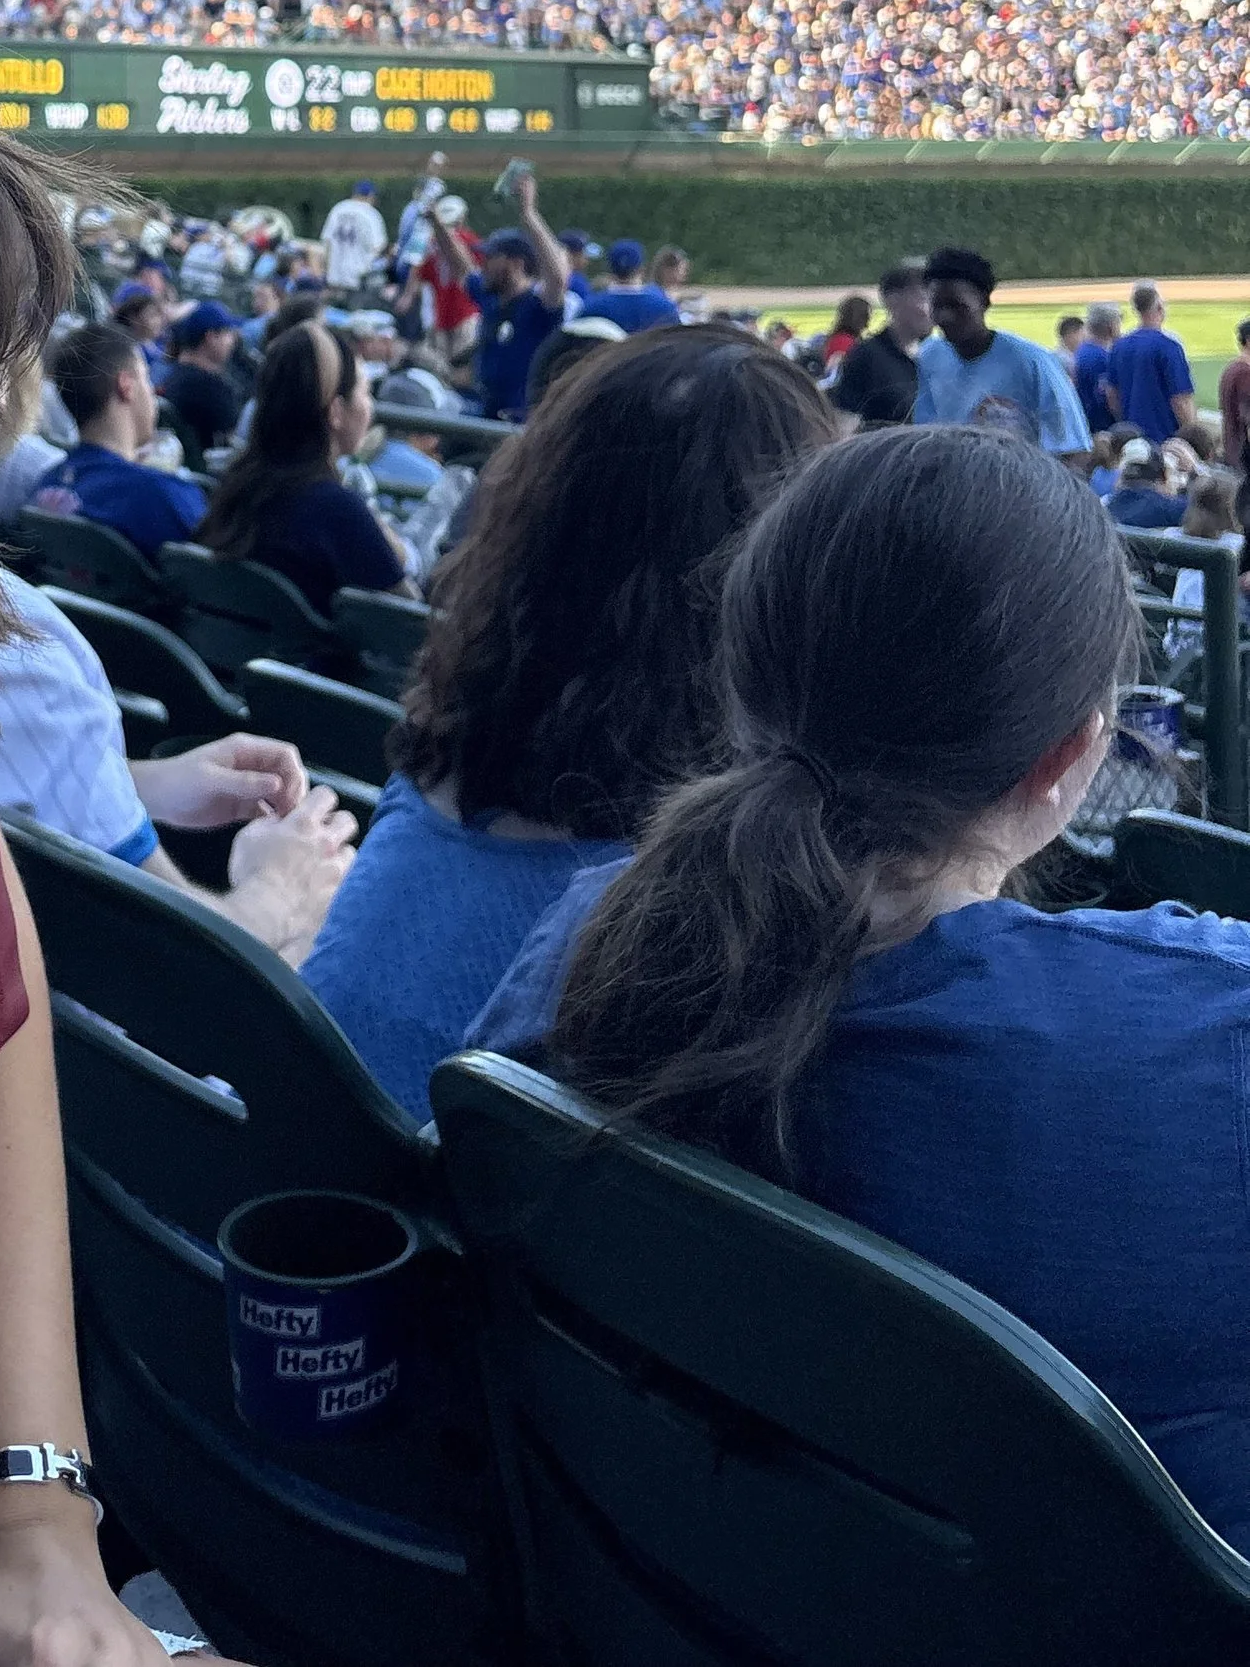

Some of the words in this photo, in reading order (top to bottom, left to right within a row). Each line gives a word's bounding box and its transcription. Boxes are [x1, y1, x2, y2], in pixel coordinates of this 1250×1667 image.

[305, 64, 343, 103] 22
[243, 1298, 315, 1336] Hefty
[278, 1343, 361, 1373] Hefty
